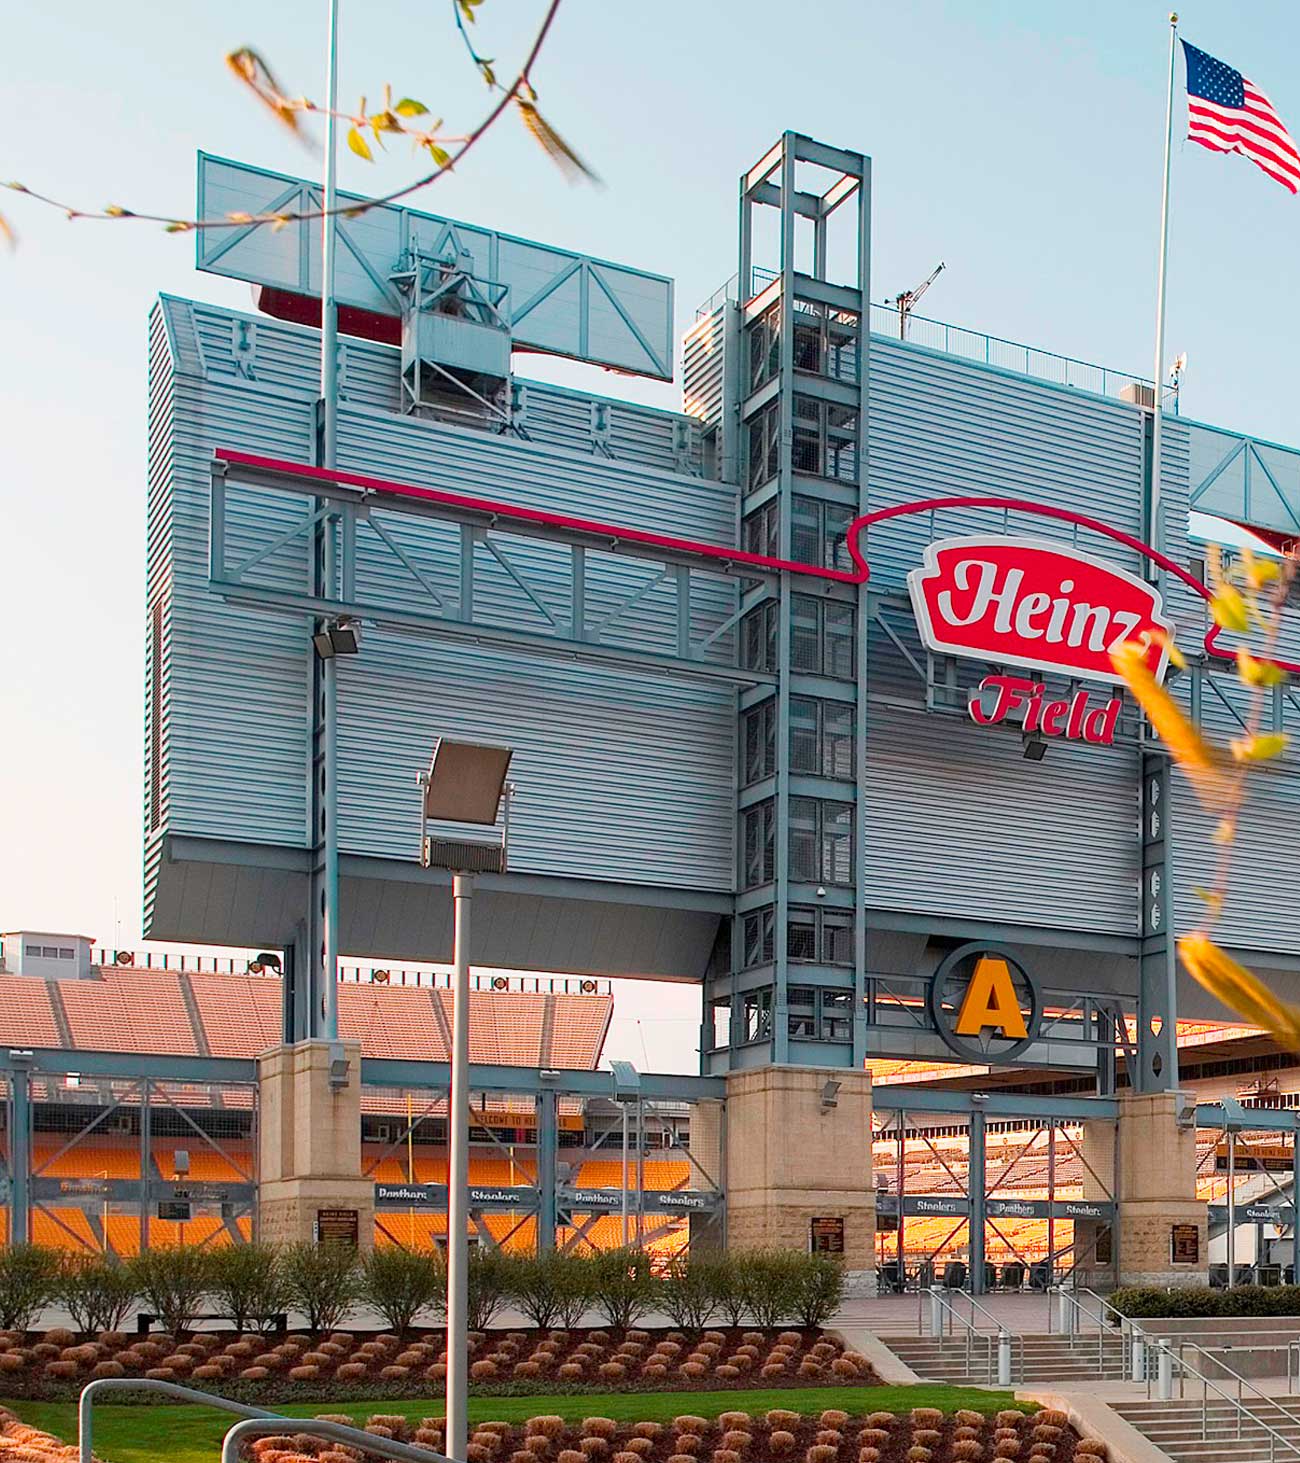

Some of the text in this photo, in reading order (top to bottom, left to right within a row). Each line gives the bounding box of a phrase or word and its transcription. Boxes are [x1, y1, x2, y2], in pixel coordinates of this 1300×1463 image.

[937, 560, 1152, 656] Heinz
[968, 676, 1122, 746] Field
[955, 958, 1029, 1038] A
[471, 1190, 520, 1202] Steelers
[659, 1195, 705, 1208] Steelers
[917, 1200, 957, 1212] Steelers
